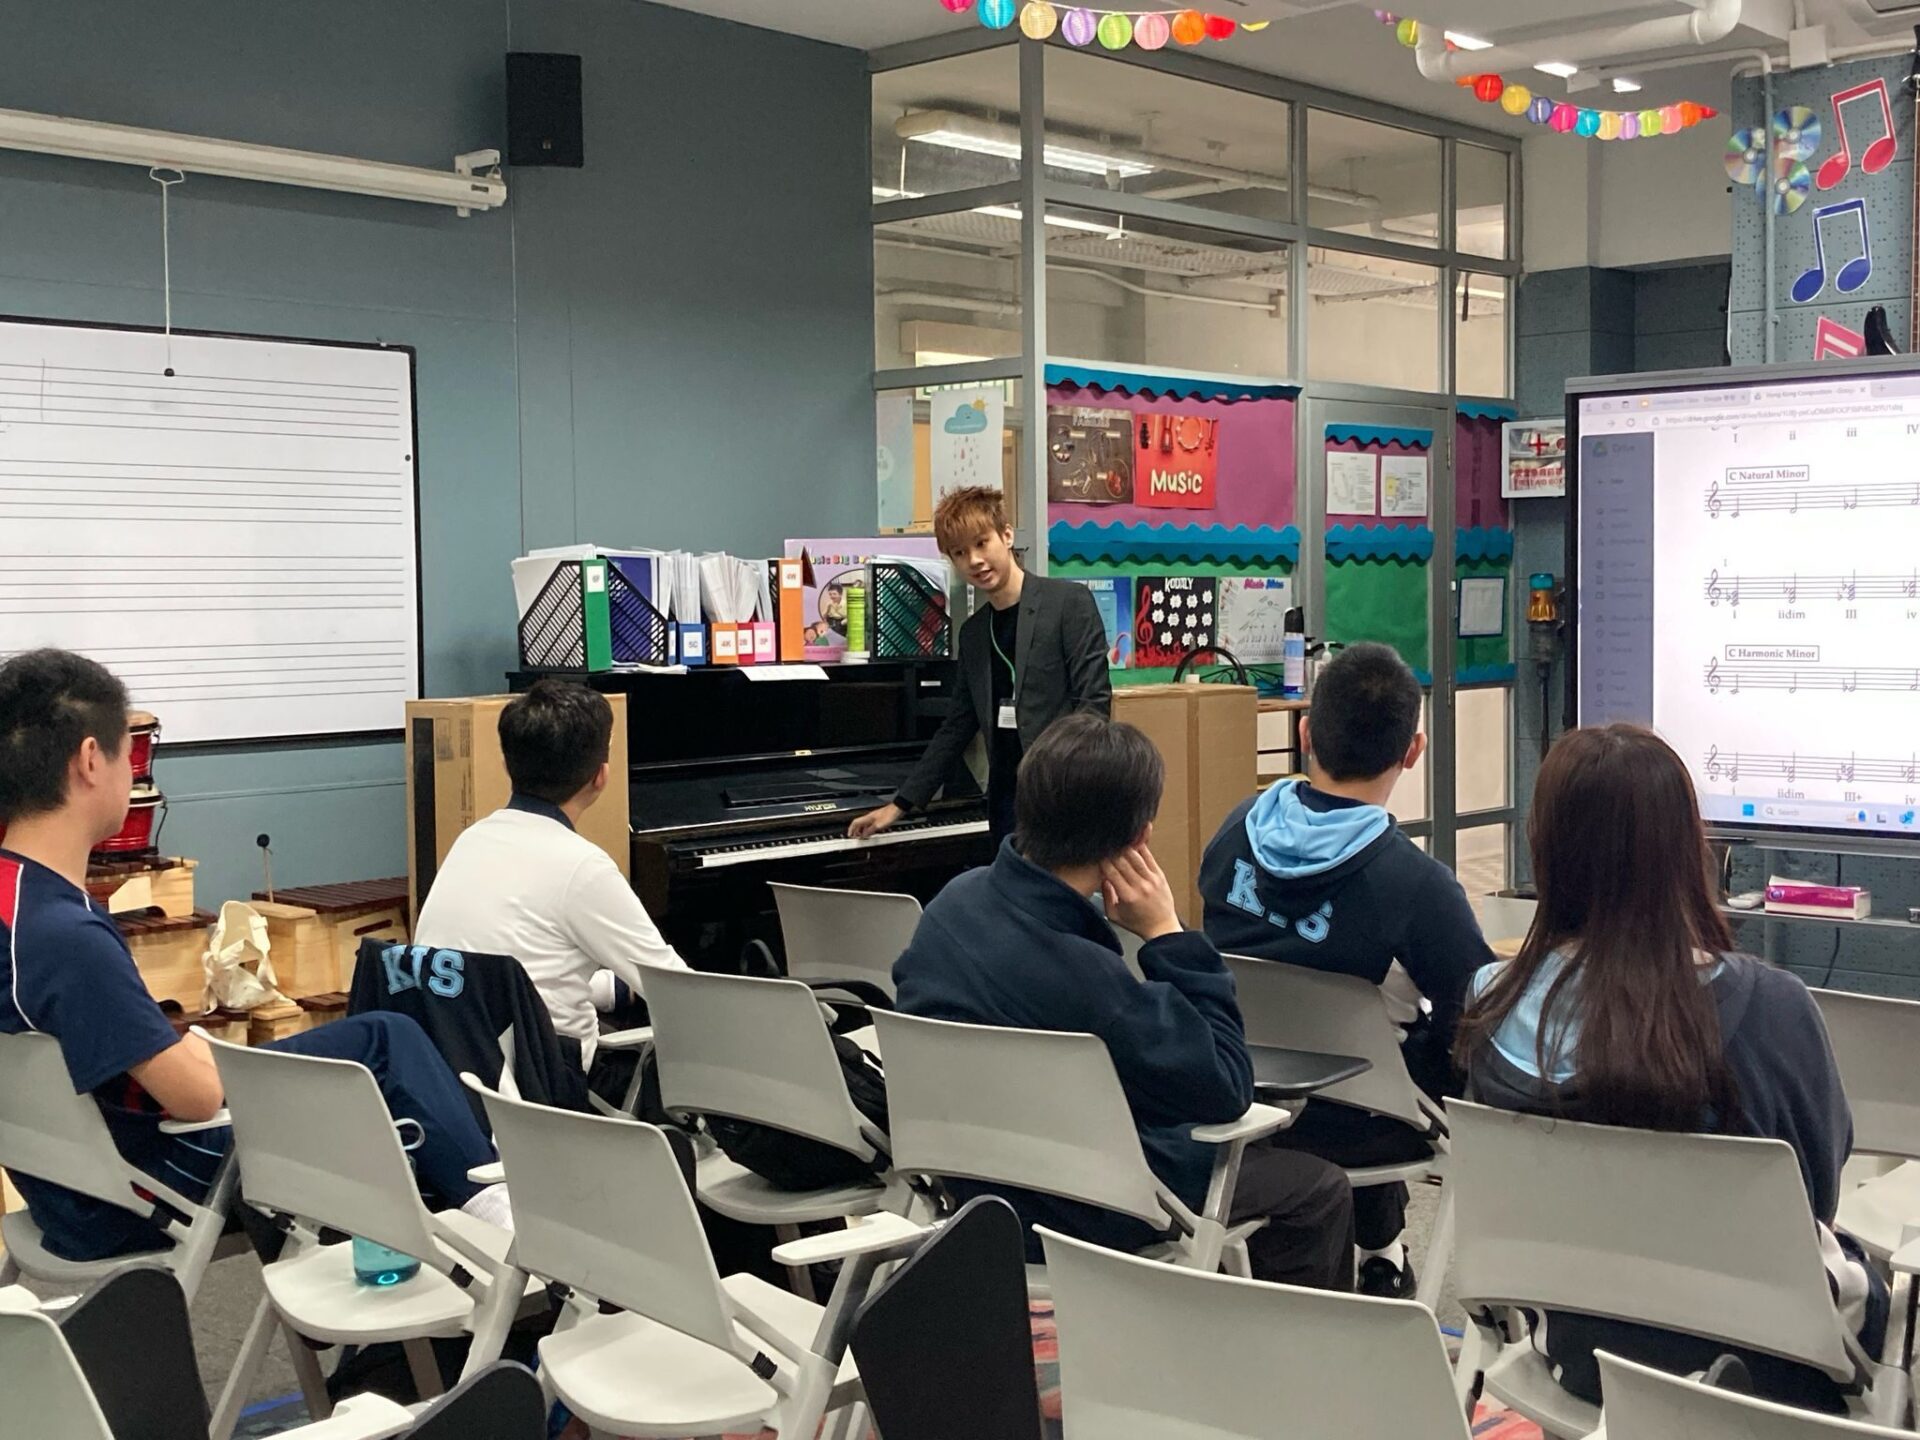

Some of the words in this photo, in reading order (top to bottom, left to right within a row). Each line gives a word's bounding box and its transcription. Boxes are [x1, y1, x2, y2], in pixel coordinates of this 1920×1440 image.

[1846, 427, 1857, 437] iii
[1729, 471, 1737, 481] C
[1738, 469, 1773, 481] Natural
[1775, 467, 1806, 480] Minor
[1150, 469, 1203, 496] Music
[1778, 609, 1806, 620] iidim
[1845, 609, 1857, 619] III
[1906, 610, 1917, 619] iv
[1729, 648, 1736, 658] C
[1738, 648, 1783, 659] Harmonic
[1786, 648, 1816, 659] Minor
[1777, 788, 1805, 800] iidim
[1905, 794, 1916, 805] iv
[381, 944, 465, 998] KIS
